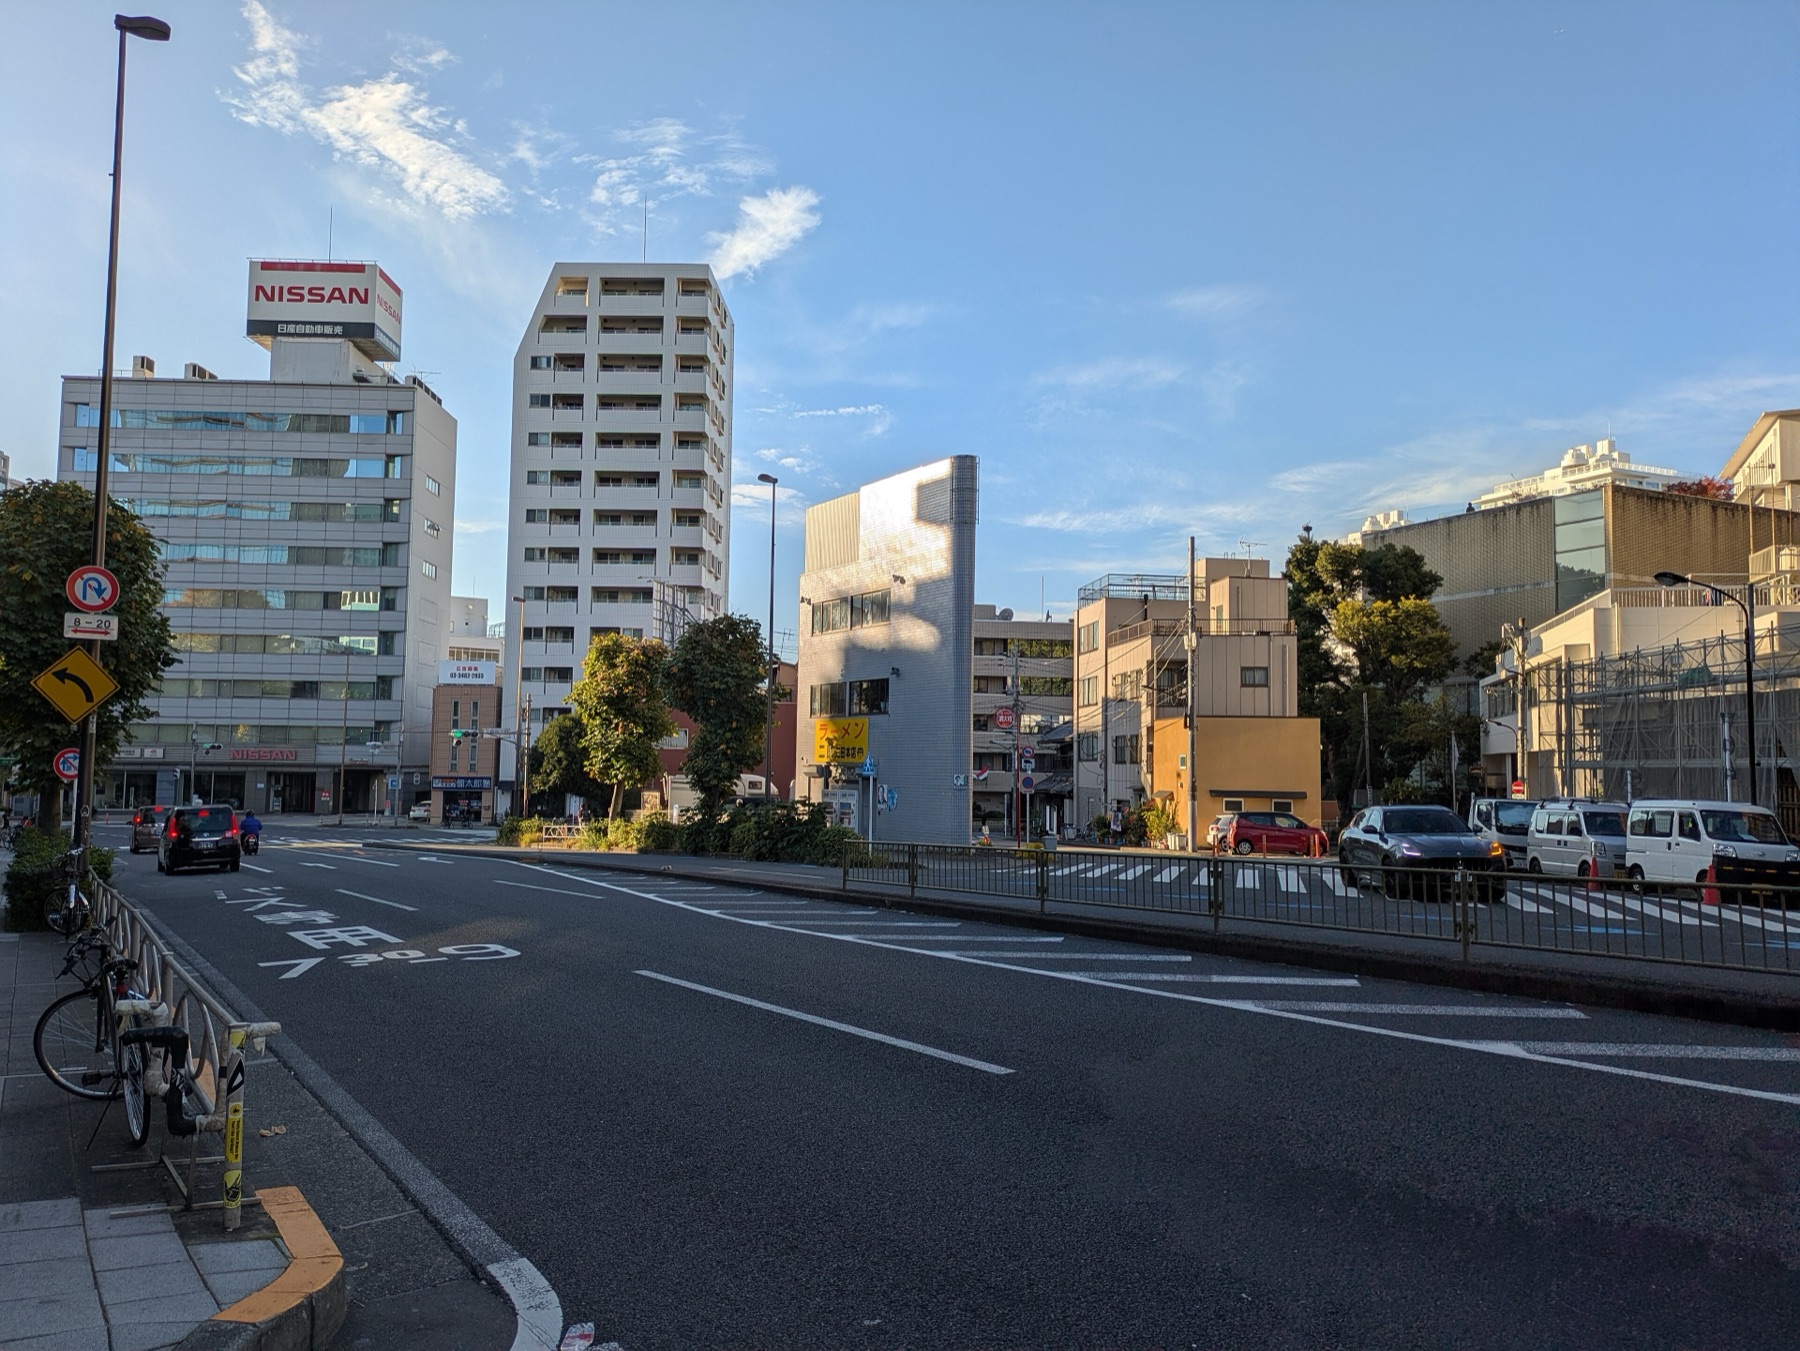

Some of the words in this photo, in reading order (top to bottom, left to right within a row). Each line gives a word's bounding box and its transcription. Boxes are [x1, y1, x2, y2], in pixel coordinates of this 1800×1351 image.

[254, 285, 370, 305] NISSAN
[376, 293, 401, 325] NISSAN
[277, 323, 344, 335] 日産自動車販売
[819, 722, 865, 741] ラーメン
[230, 748, 297, 760] NISSAN
